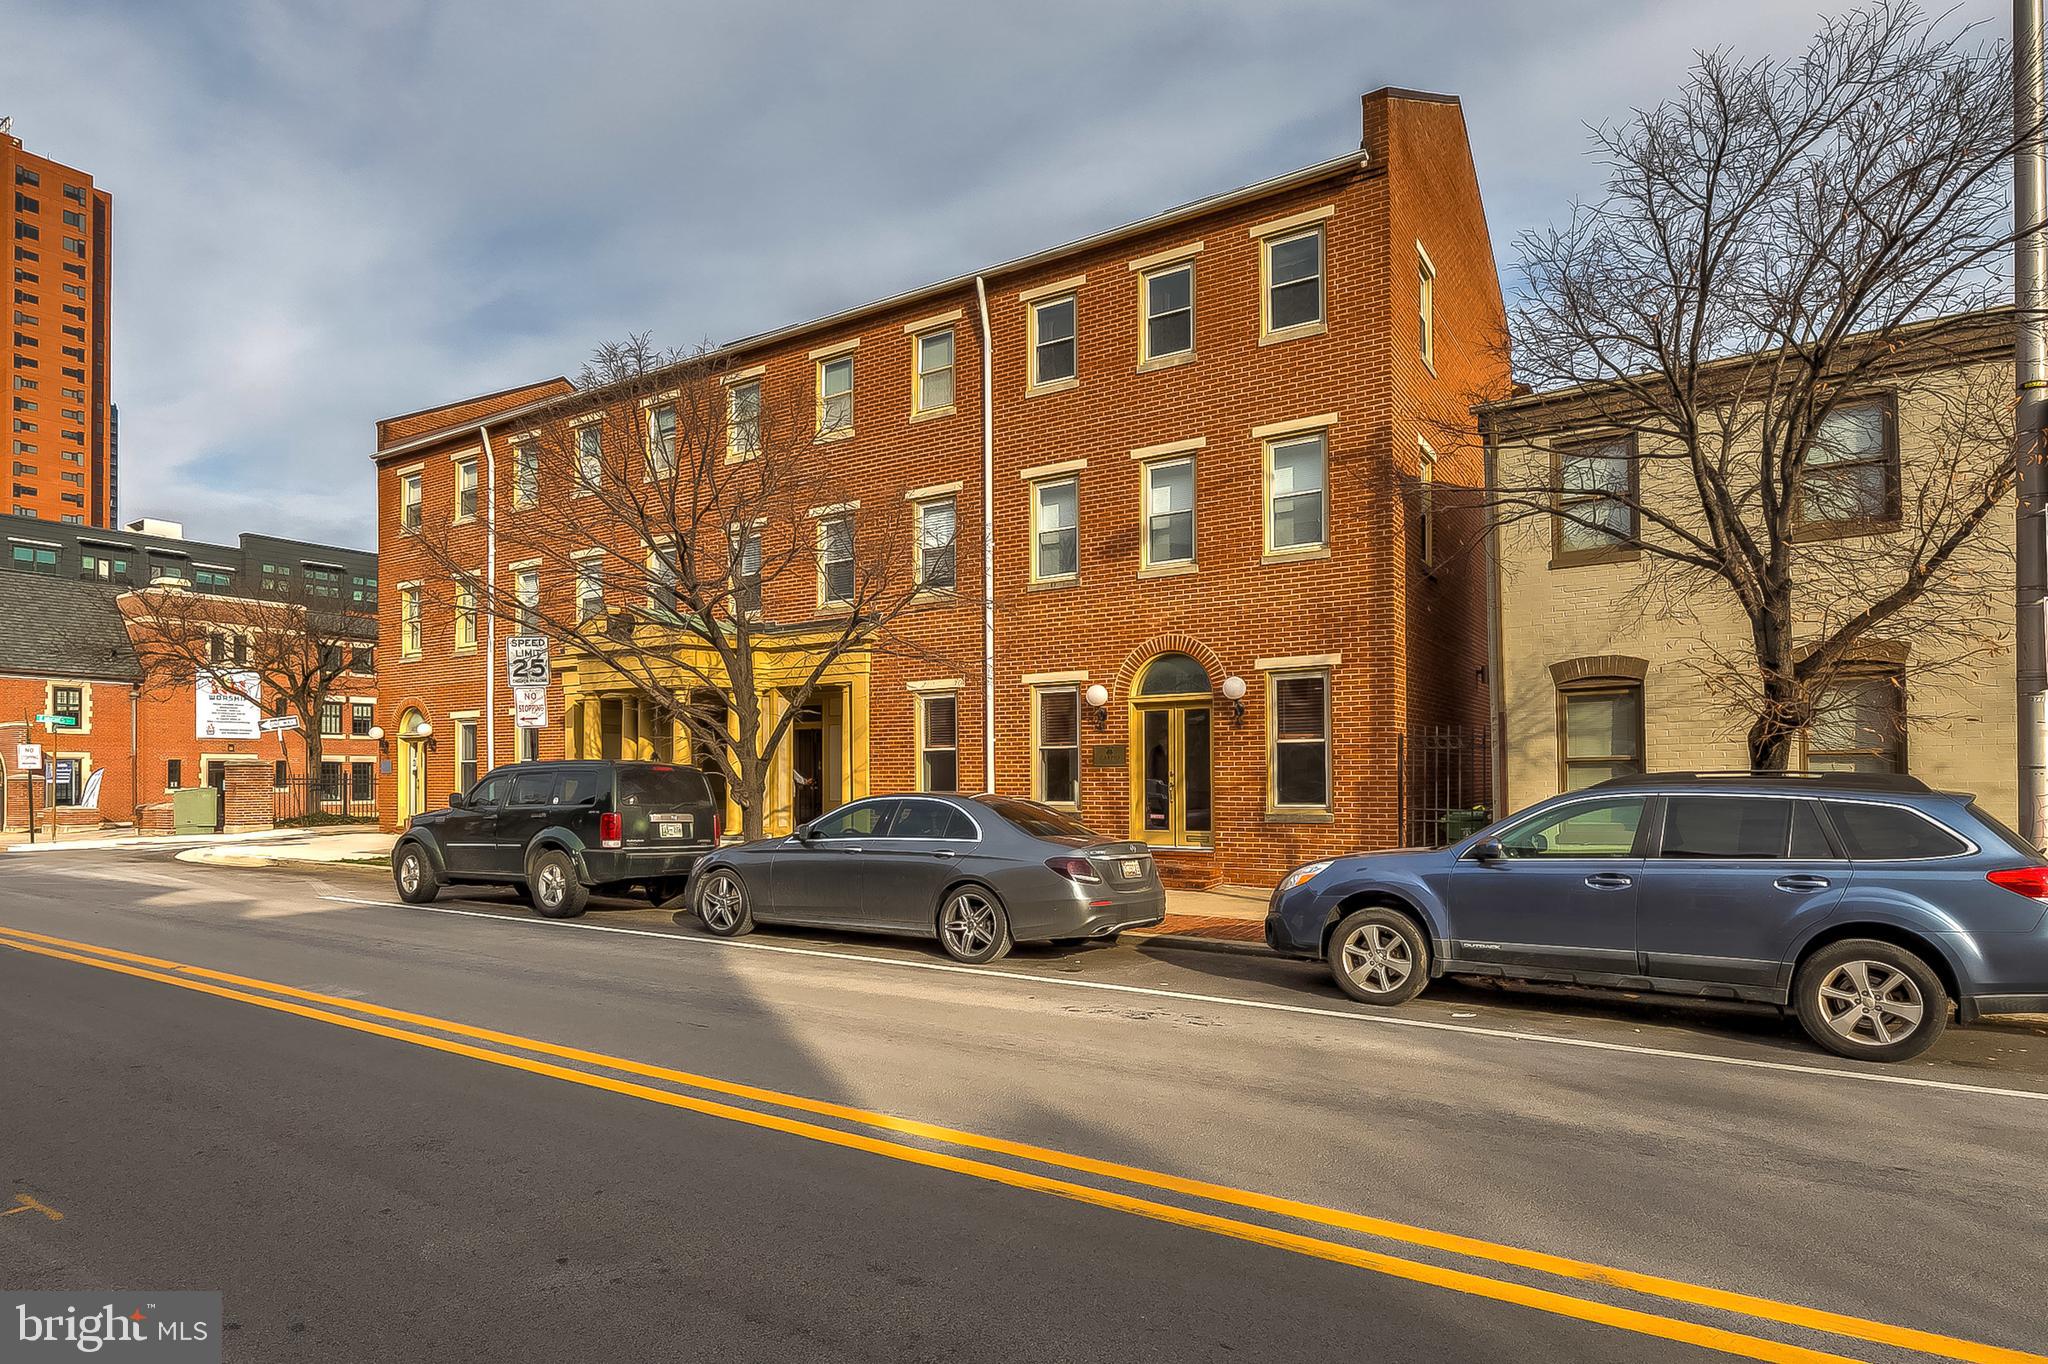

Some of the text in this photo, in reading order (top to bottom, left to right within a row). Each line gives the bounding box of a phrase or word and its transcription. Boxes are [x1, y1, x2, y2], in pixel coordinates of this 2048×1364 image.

[511, 638, 545, 647] SPEED
[515, 649, 543, 658] LIMIT
[512, 659, 545, 678] 25
[524, 692, 537, 701] NO
